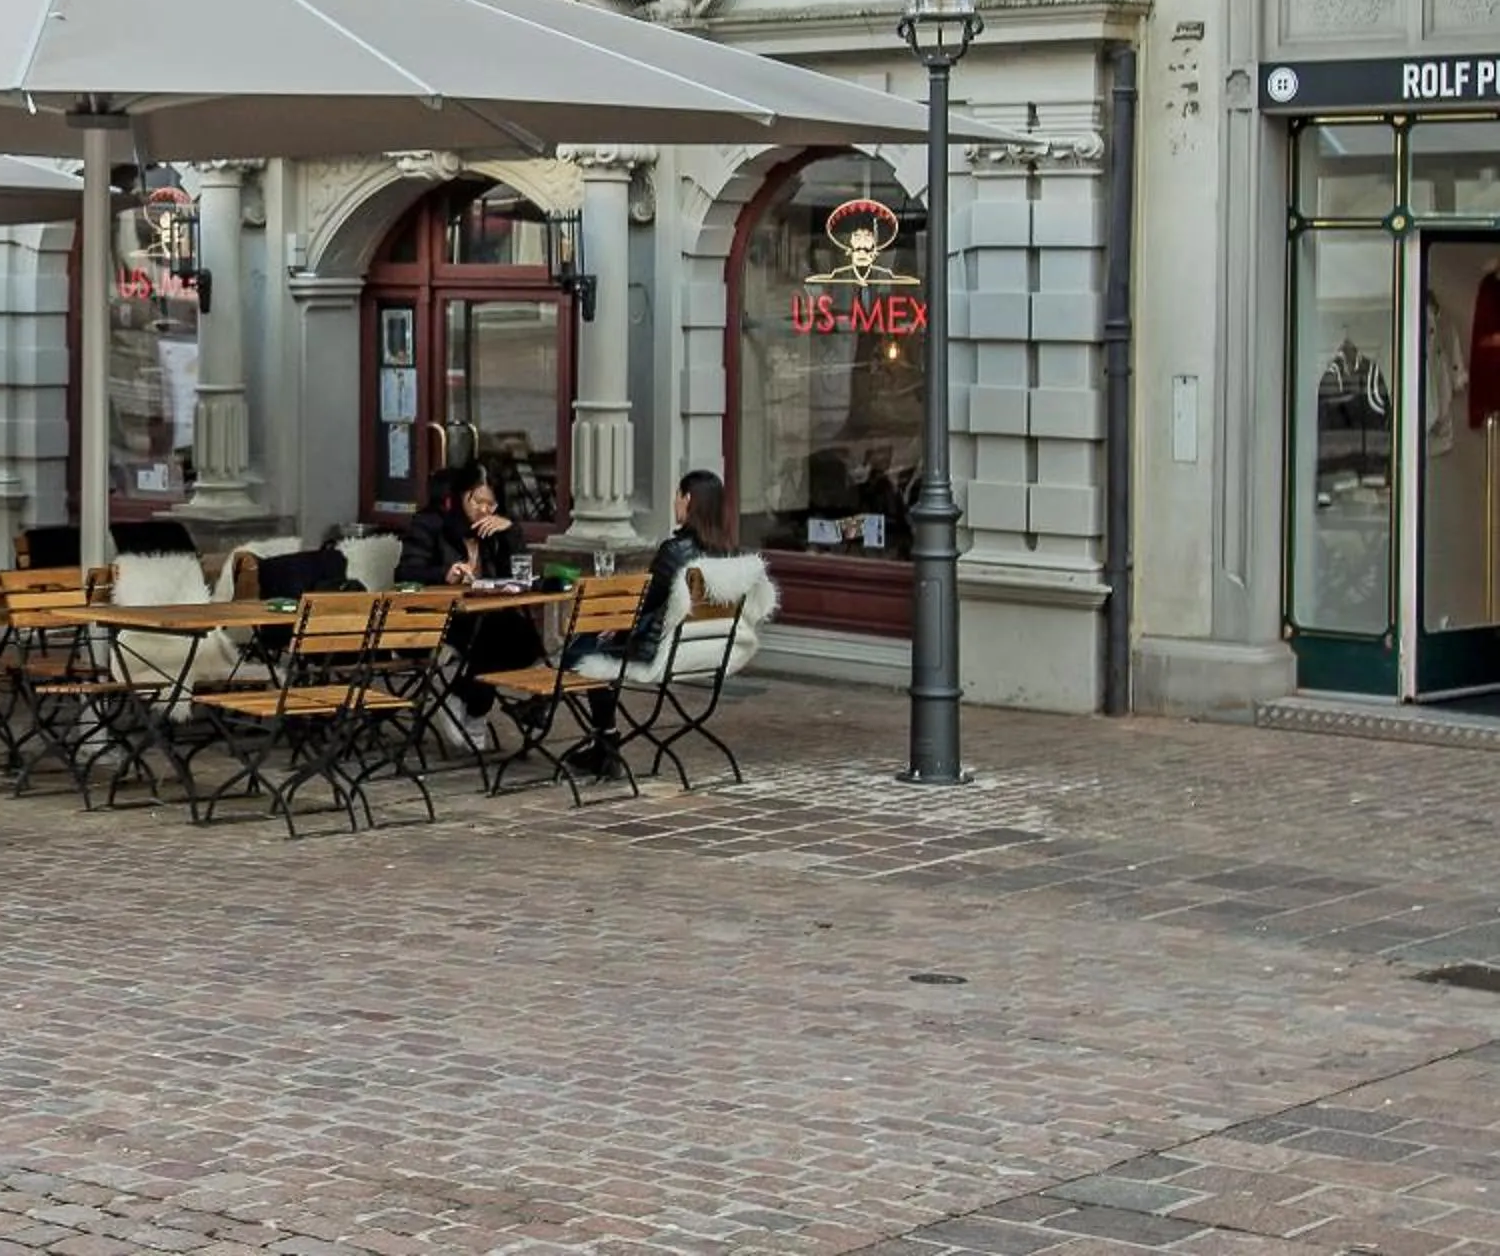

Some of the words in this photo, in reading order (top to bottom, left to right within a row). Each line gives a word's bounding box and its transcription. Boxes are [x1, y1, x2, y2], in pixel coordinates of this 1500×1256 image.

[1402, 61, 1471, 99] ROLF
[1477, 59, 1500, 97] P
[792, 294, 929, 334] US-MEX
